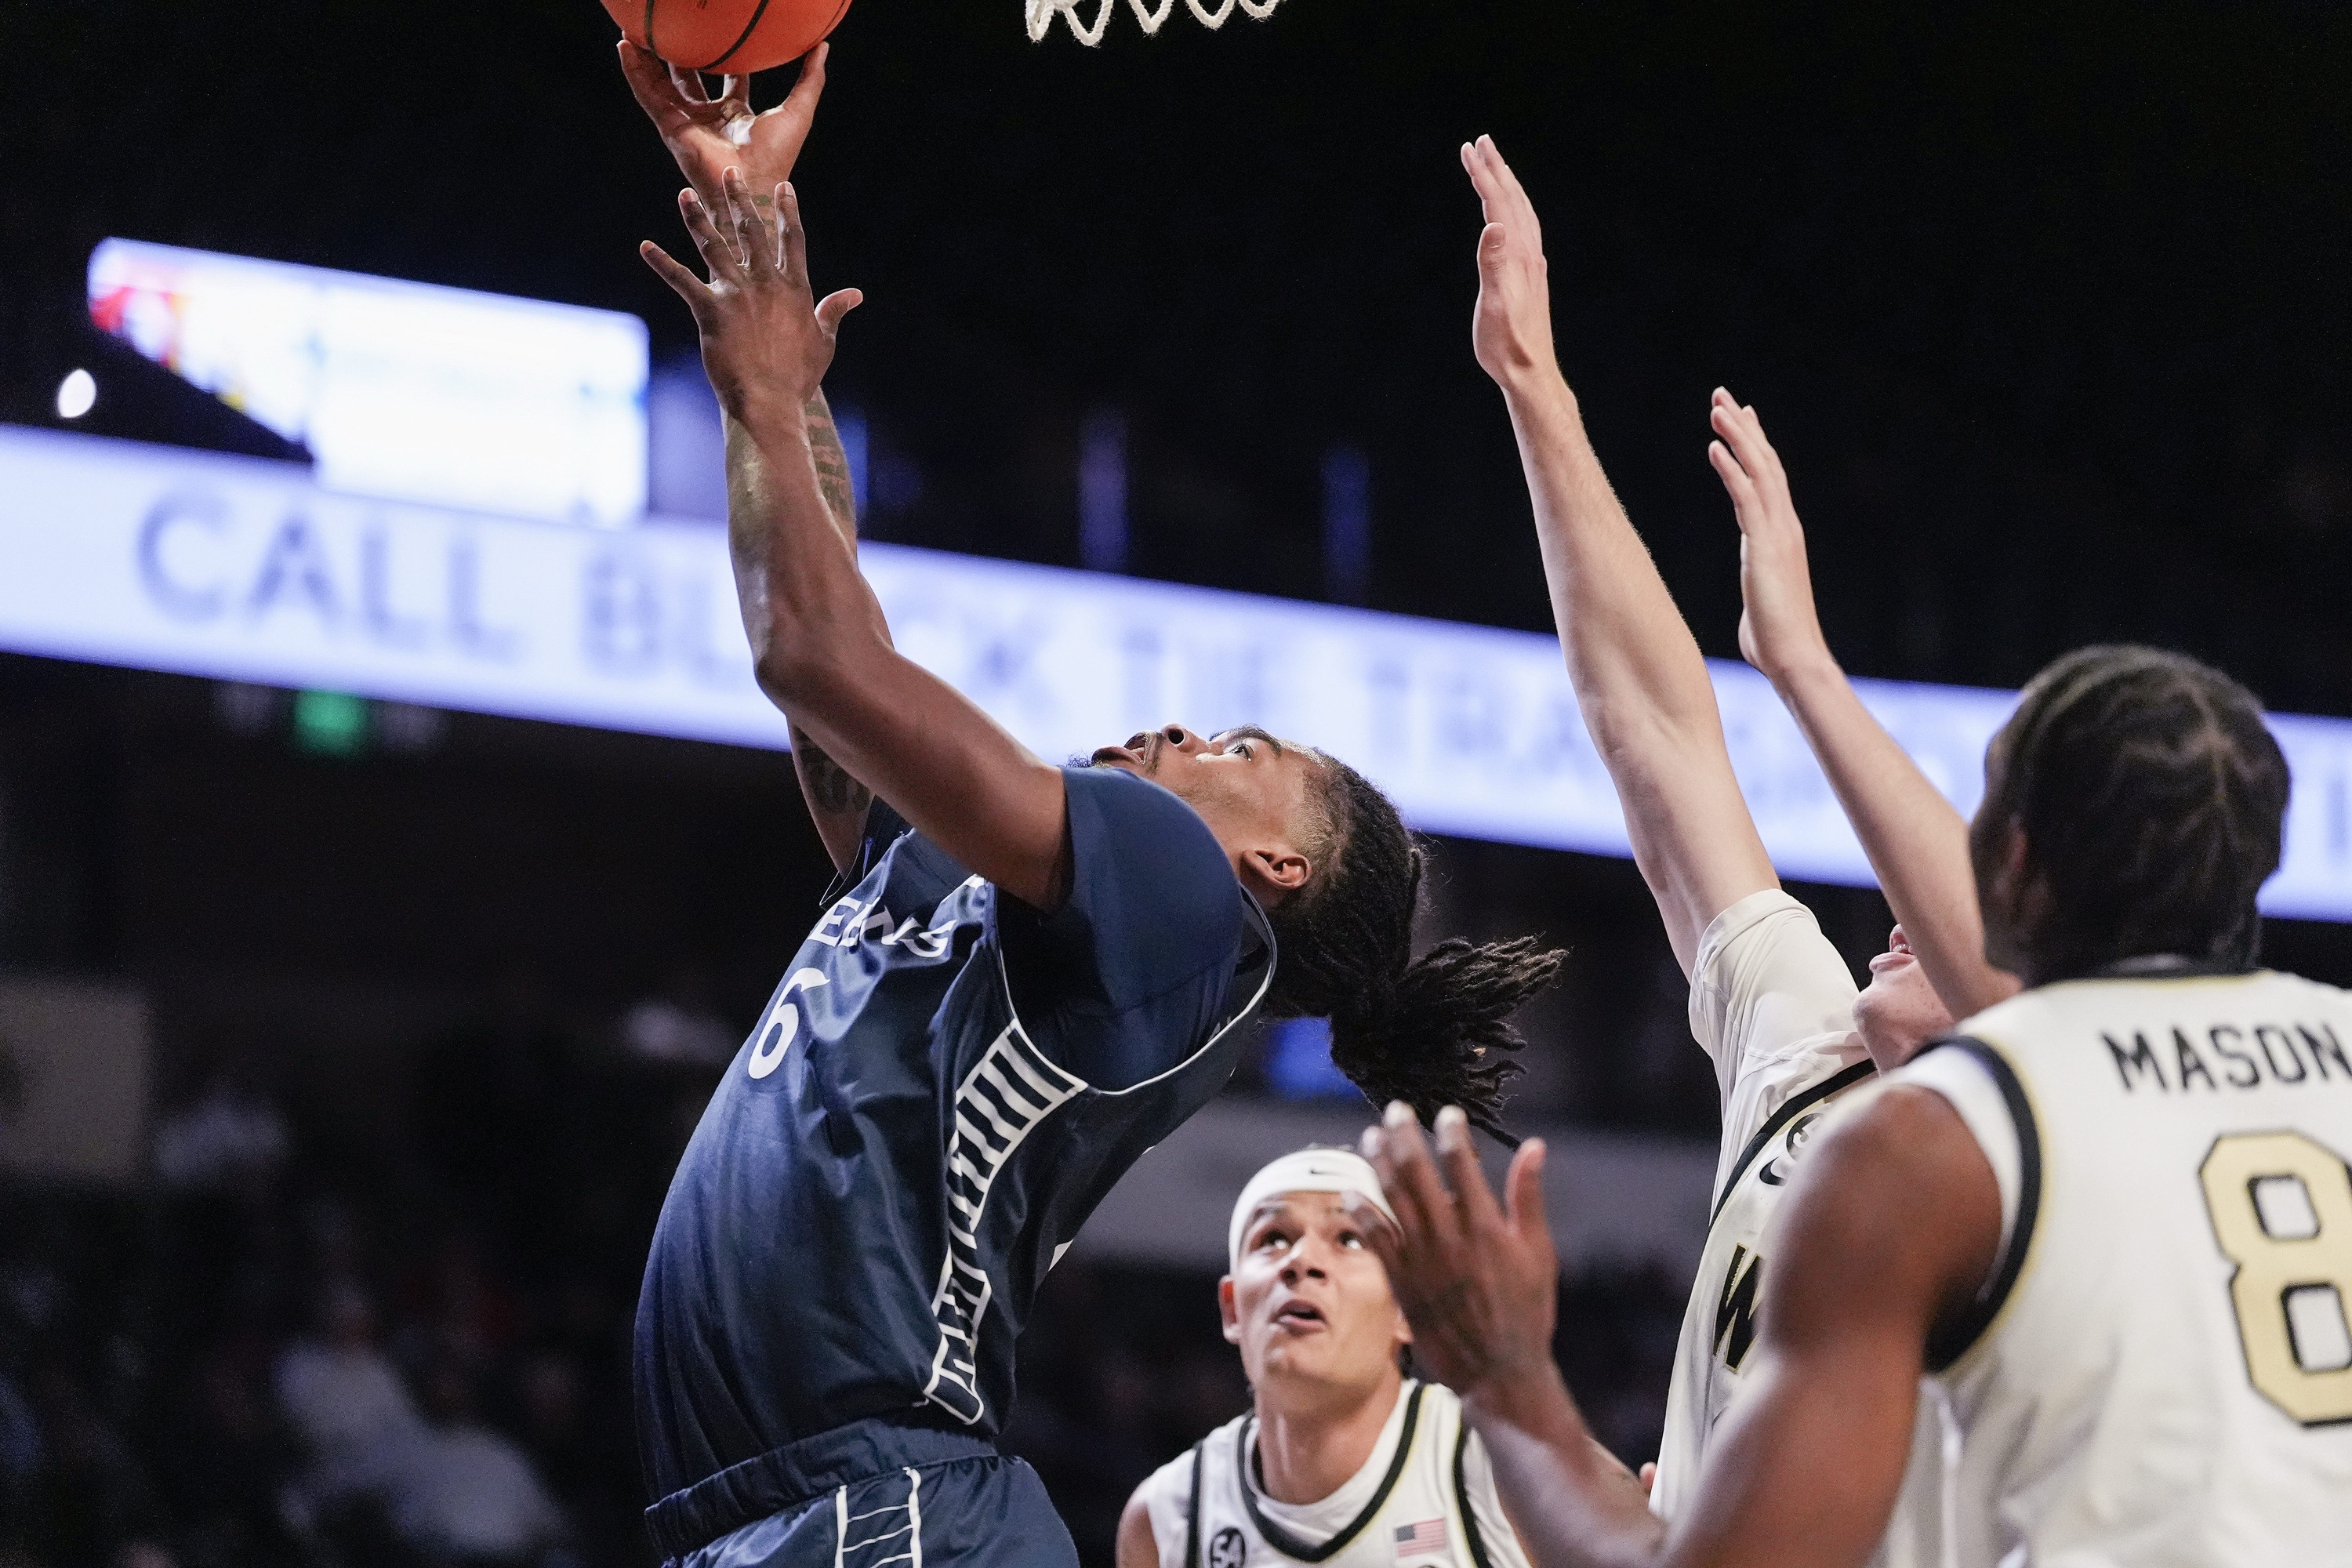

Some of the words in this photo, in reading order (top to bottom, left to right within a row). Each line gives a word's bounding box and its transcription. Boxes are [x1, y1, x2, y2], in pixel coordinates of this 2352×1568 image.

[135, 485, 522, 662] CALL
[747, 967, 831, 1080] 6
[2097, 1019, 2352, 1091] MASON
[2198, 1127, 2352, 1430] 8
